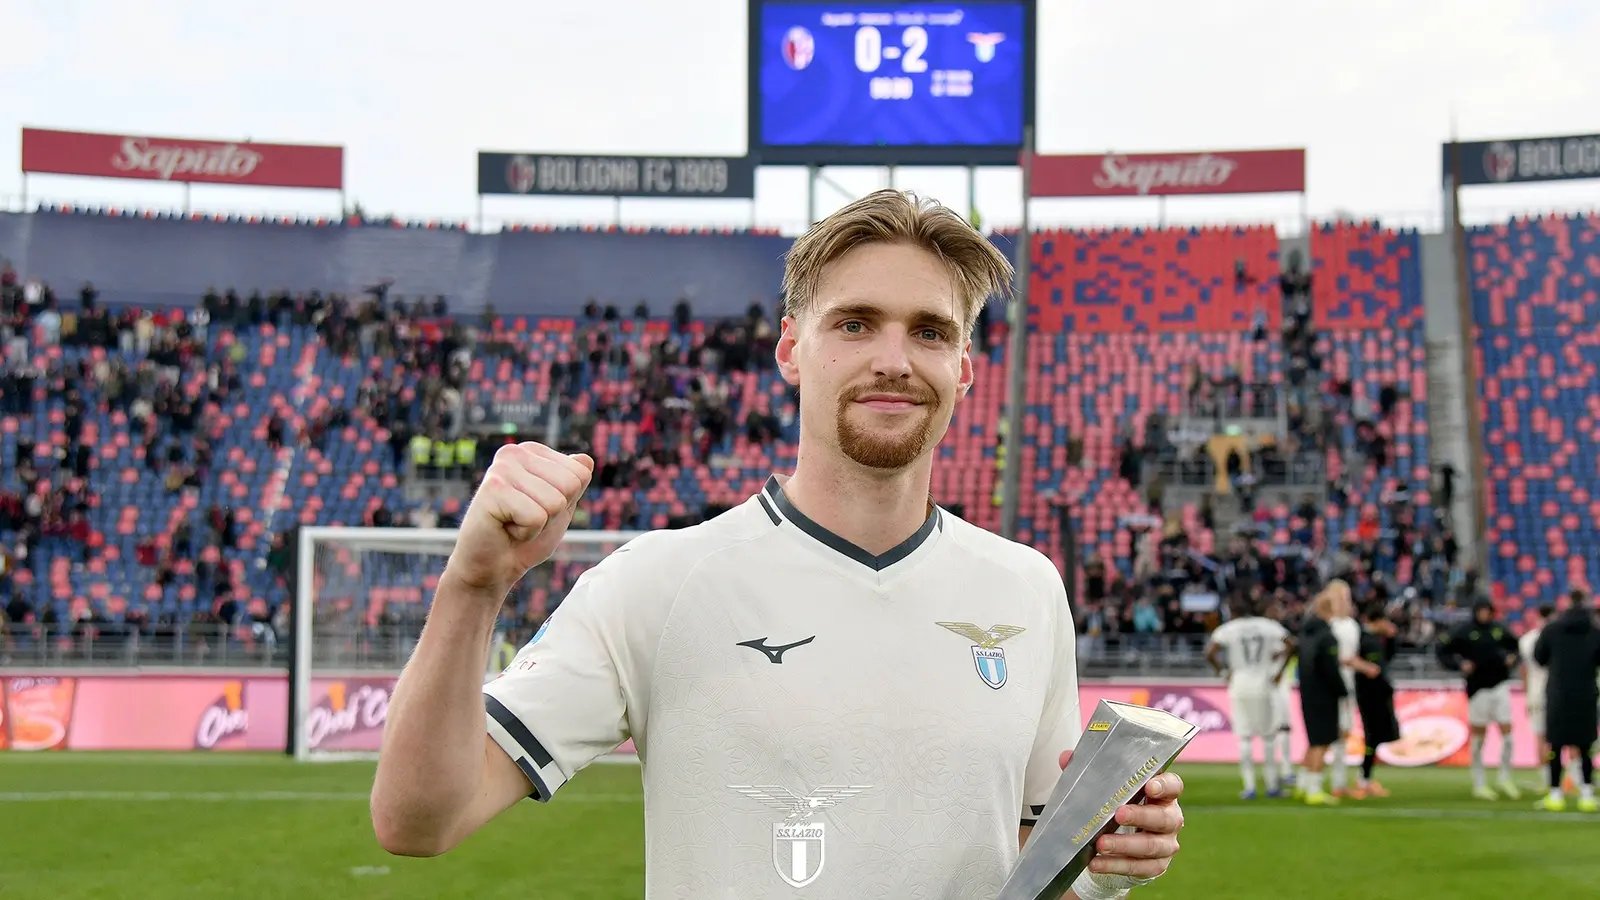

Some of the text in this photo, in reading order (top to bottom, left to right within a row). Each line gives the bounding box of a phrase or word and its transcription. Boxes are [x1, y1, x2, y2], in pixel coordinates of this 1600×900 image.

[855, 26, 928, 73] 0-2
[111, 137, 264, 180] Saputo
[537, 156, 729, 193] BOLOGNA FC 1909
[1092, 153, 1239, 195] Saputo
[1239, 634, 1265, 665] 17
[1072, 756, 1160, 844] PLAYER OF THE MATCH
